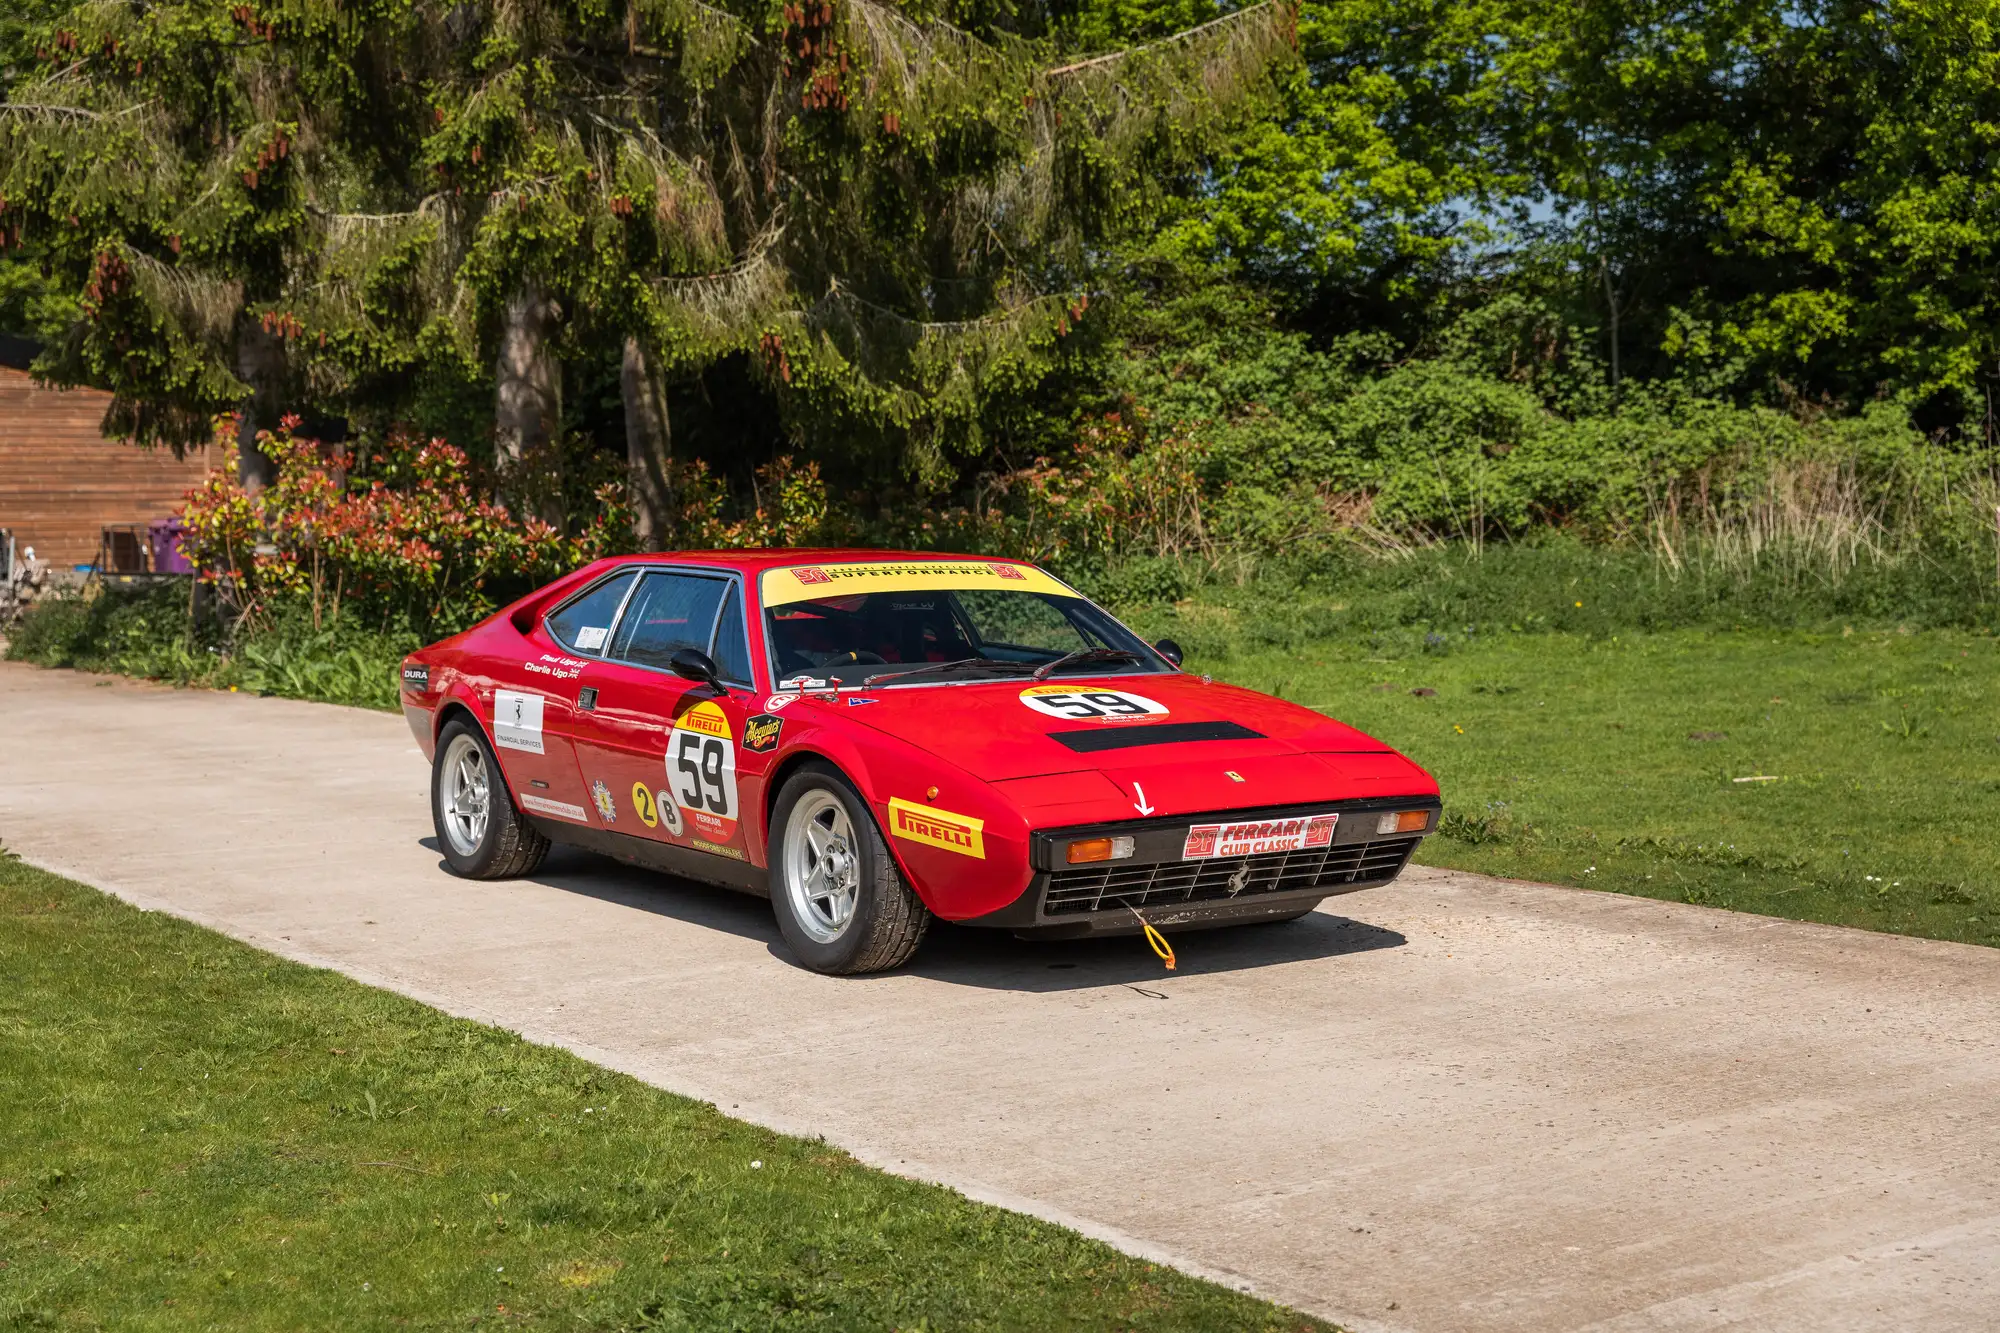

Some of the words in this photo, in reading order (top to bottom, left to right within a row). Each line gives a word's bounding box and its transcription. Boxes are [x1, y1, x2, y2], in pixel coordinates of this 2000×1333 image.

[829, 569, 996, 579] SUPERFORMANCE
[540, 654, 561, 662] Paul
[559, 658, 577, 666] Ugo
[404, 670, 428, 679] DURA
[524, 662, 551, 675] Charlie
[552, 667, 568, 679] Ugo
[1032, 693, 1150, 717] 59
[686, 711, 725, 733] PIRELLI
[497, 734, 520, 745] FINANCIAL
[519, 738, 542, 749] SERVICES
[678, 733, 728, 815] 59
[636, 787, 655, 822] 2
[695, 813, 722, 827] FERRARI
[897, 808, 972, 848] PIRELLI
[1222, 820, 1306, 841] FERRARI
[1220, 843, 1250, 856] CLUB
[1253, 838, 1300, 854] CLASSIC
